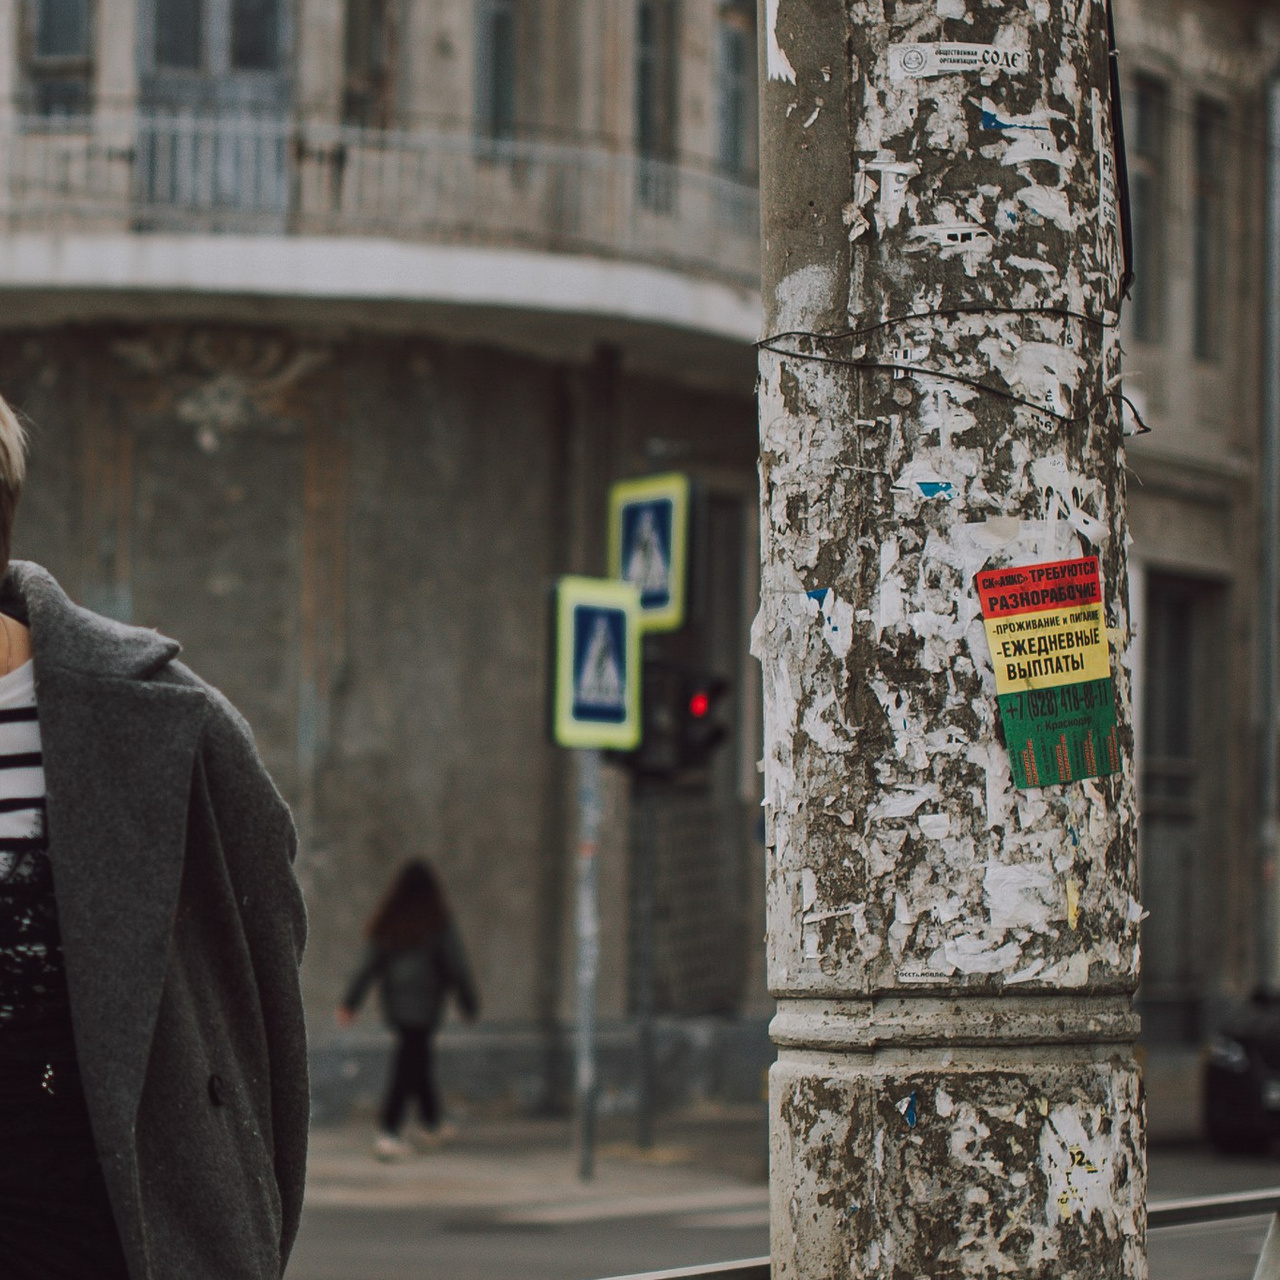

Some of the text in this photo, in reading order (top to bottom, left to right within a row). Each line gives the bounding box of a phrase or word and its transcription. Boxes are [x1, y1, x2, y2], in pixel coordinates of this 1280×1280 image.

[982, 49, 1023, 68] СОДЕ
[1028, 561, 1096, 583] ТРЕБУЮТСЯ
[988, 581, 1097, 612] РАЗНОРАБОЧИЕ
[1006, 653, 1085, 681] ВЫПЛАТЫ
[1006, 694, 1023, 720] +7
[1027, 689, 1058, 721] (928)
